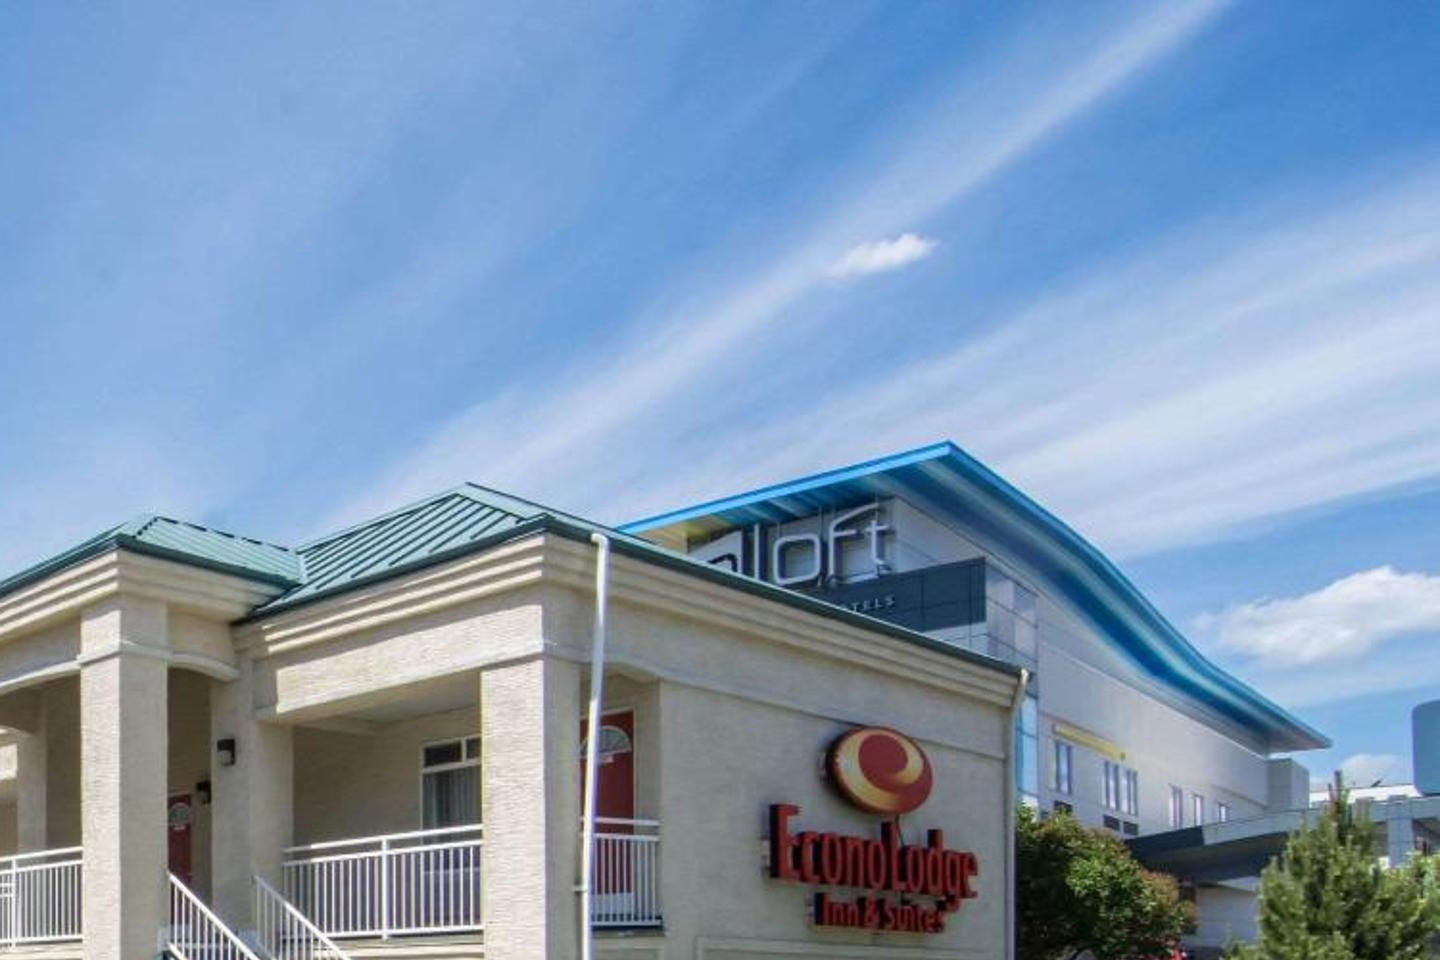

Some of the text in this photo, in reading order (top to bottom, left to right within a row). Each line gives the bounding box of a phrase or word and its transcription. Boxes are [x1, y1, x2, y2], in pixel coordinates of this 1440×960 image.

[814, 892, 945, 933] Inn & Suites
